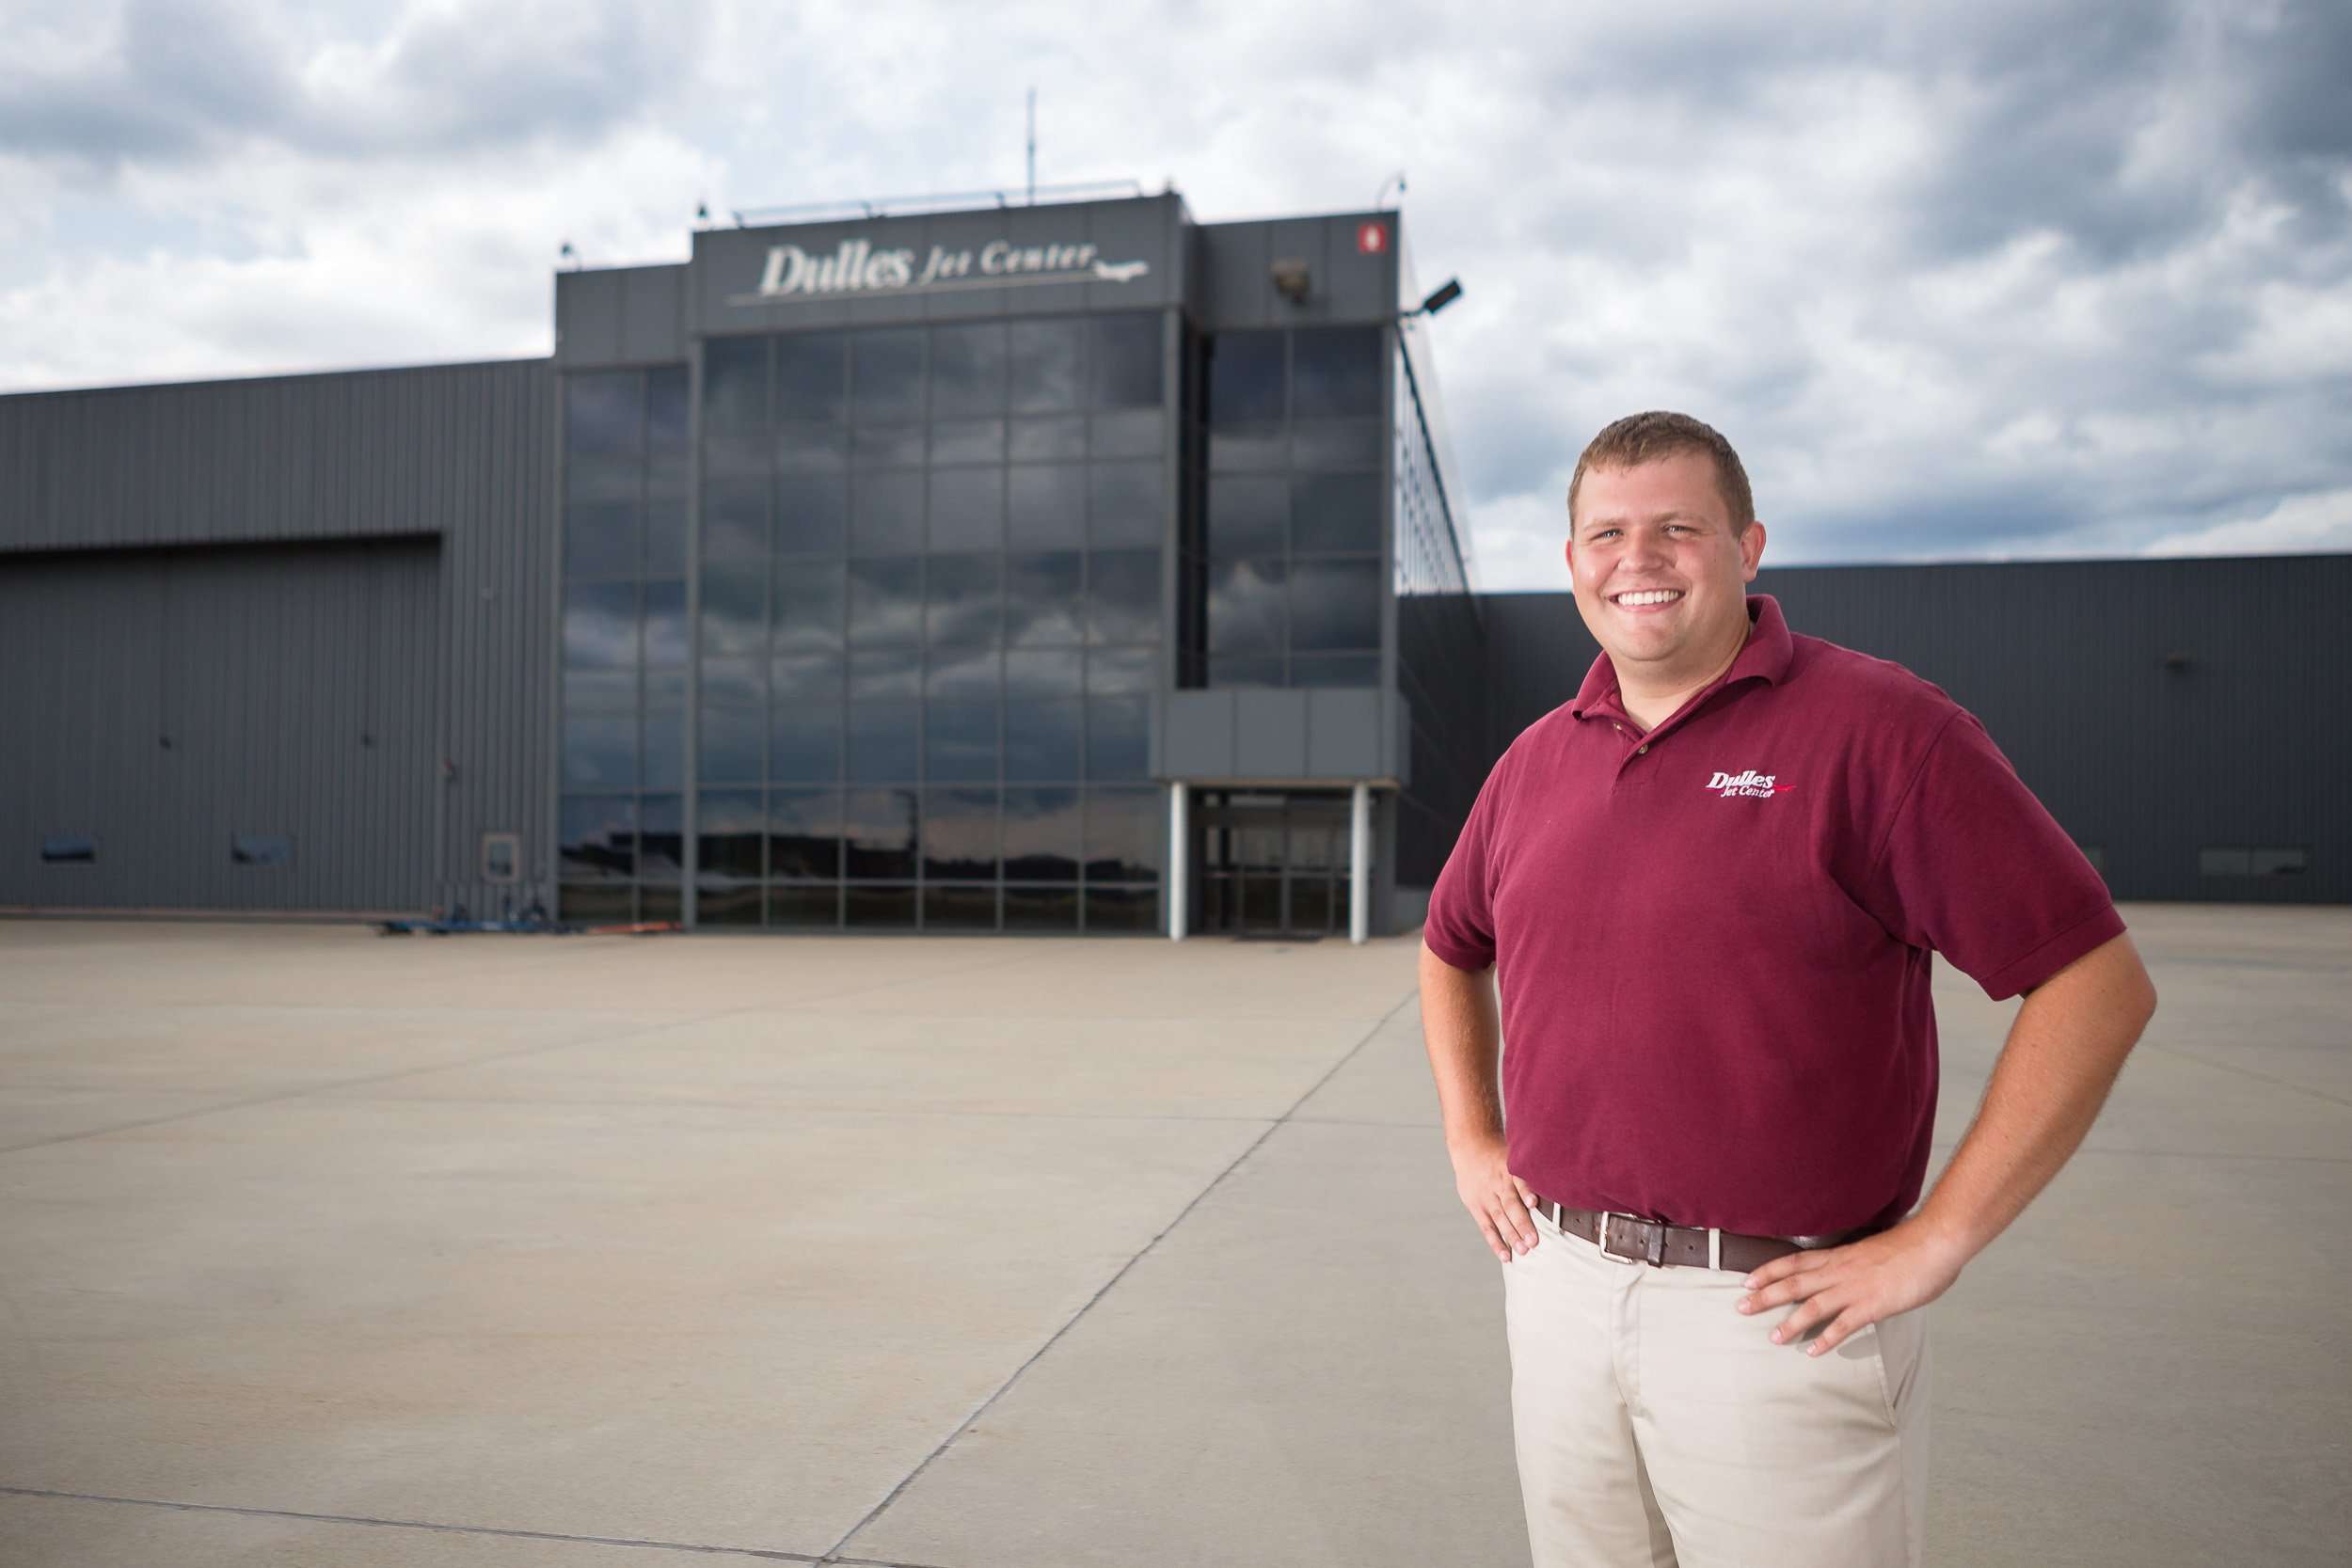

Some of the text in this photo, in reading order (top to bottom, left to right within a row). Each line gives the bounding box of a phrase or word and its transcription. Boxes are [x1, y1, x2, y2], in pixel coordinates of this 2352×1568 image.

[759, 239, 1096, 296] Dulles Jet Center
[1706, 770, 1776, 788] Dulles
[1721, 785, 1775, 799] Jet Center
